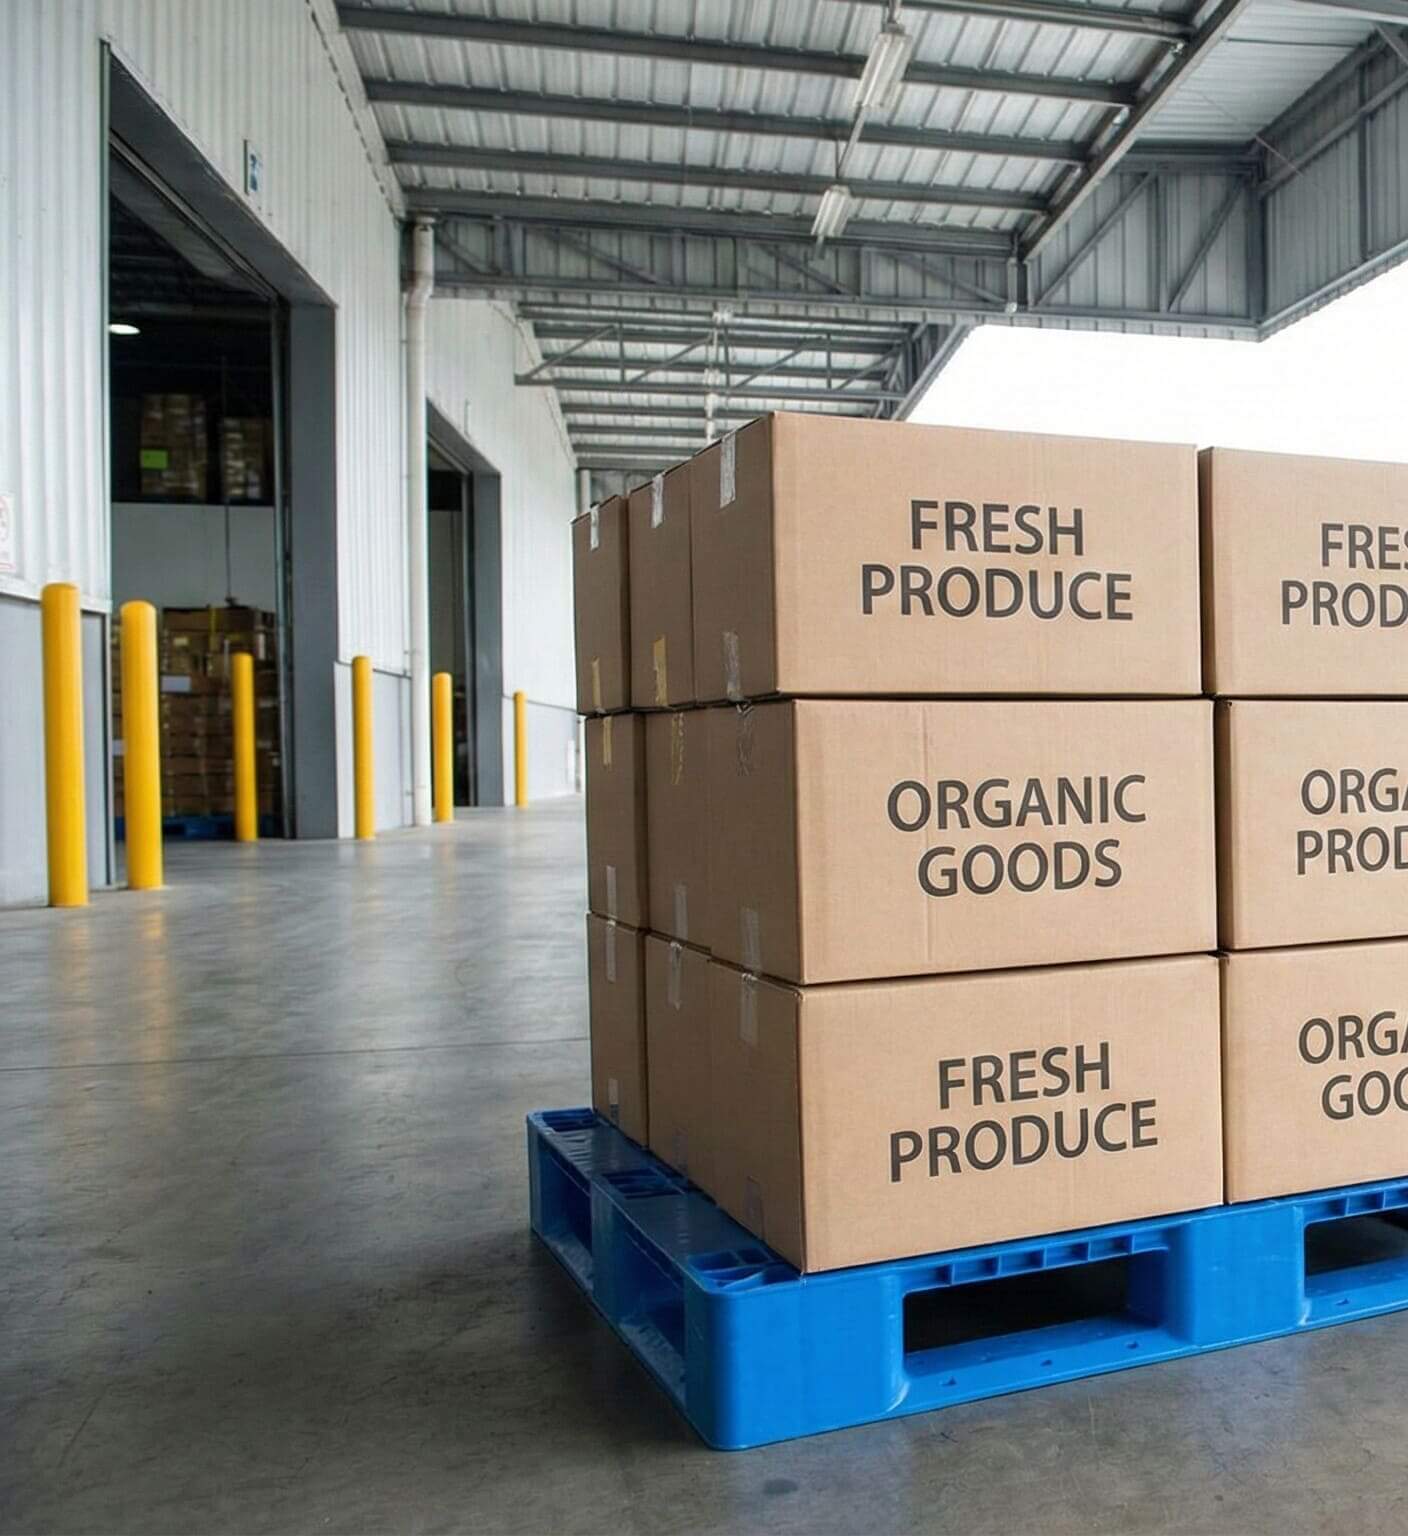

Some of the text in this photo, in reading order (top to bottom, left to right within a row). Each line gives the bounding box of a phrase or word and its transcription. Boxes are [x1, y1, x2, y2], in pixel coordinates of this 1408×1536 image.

[911, 500, 1083, 556] FRESH
[862, 564, 1134, 620] PRODUCE
[887, 774, 1146, 831] ORGANIC
[918, 839, 1122, 897] GOODS
[939, 1042, 1110, 1110] FRESH
[890, 1099, 1158, 1182] PRODUCE
